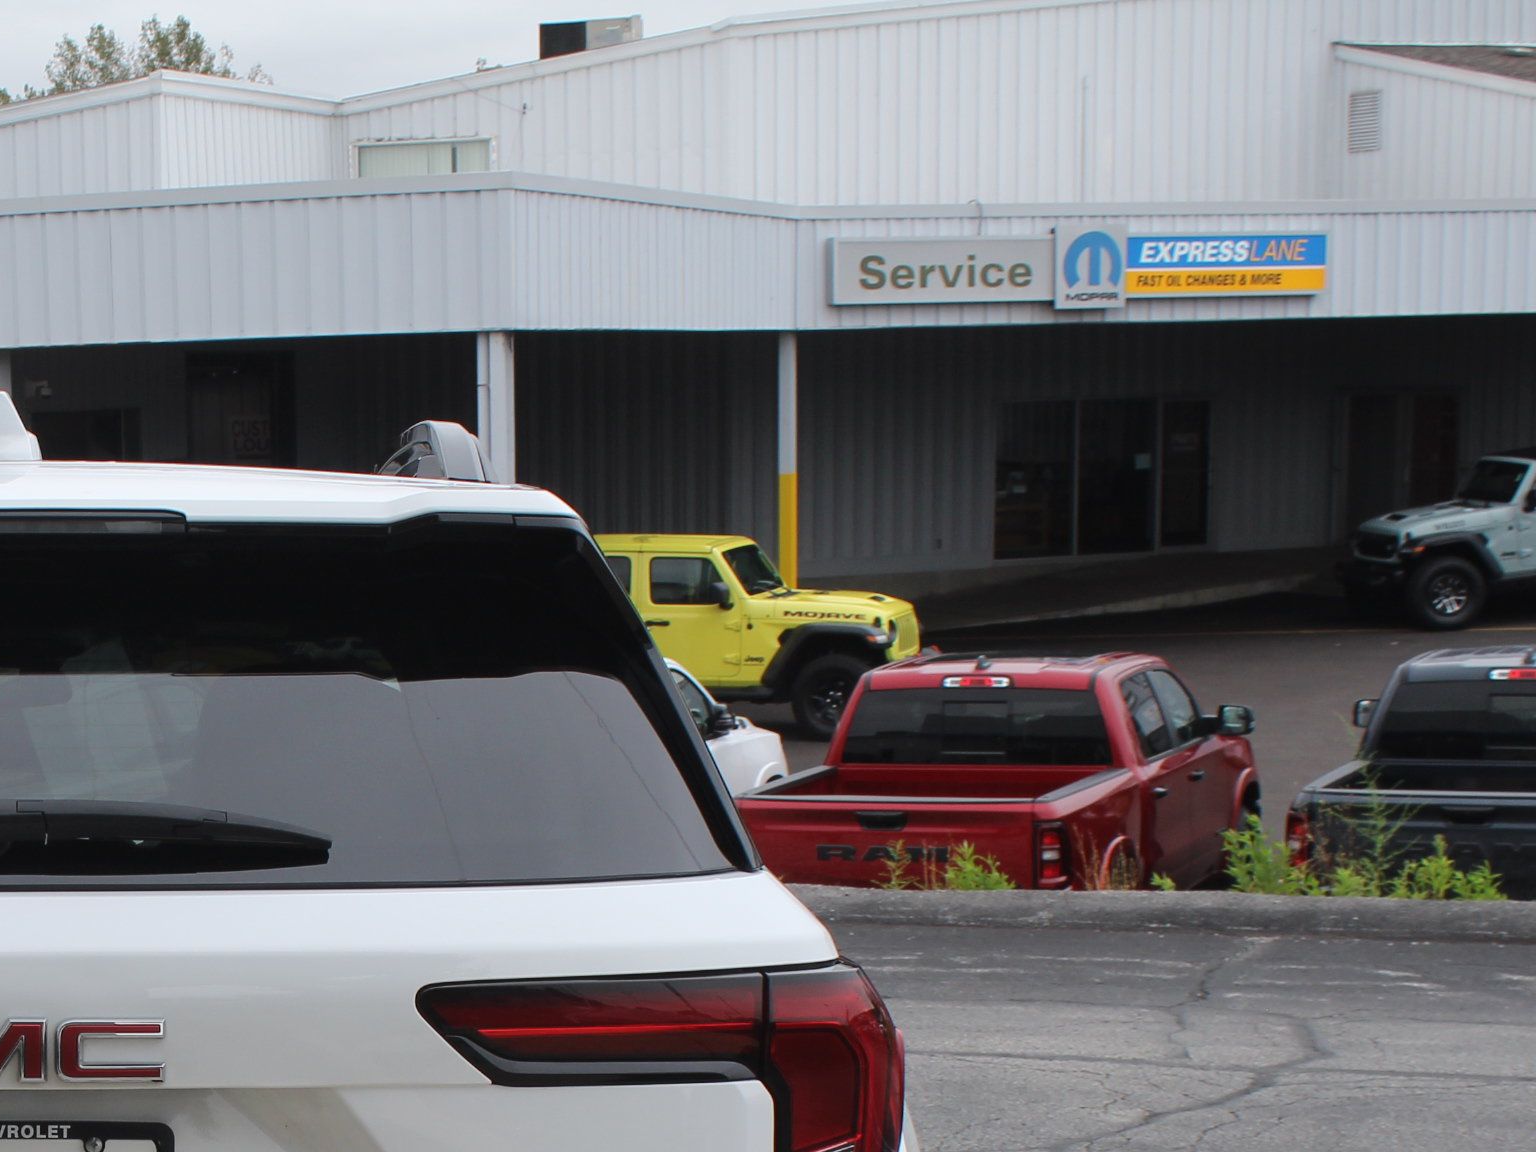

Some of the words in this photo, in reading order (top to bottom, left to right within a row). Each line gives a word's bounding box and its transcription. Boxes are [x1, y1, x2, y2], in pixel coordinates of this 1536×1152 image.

[1138, 239, 1309, 263] EXPRESSLANE
[859, 254, 1032, 290] Service
[1136, 275, 1163, 287] FAST
[1166, 275, 1181, 287] OIL
[1185, 274, 1236, 287] CHANGES
[1239, 274, 1247, 286] &
[1250, 273, 1282, 286] MORE
[1065, 292, 1118, 301] MOPAR
[232, 419, 272, 436] CUST
[783, 610, 867, 620] MOJAVE
